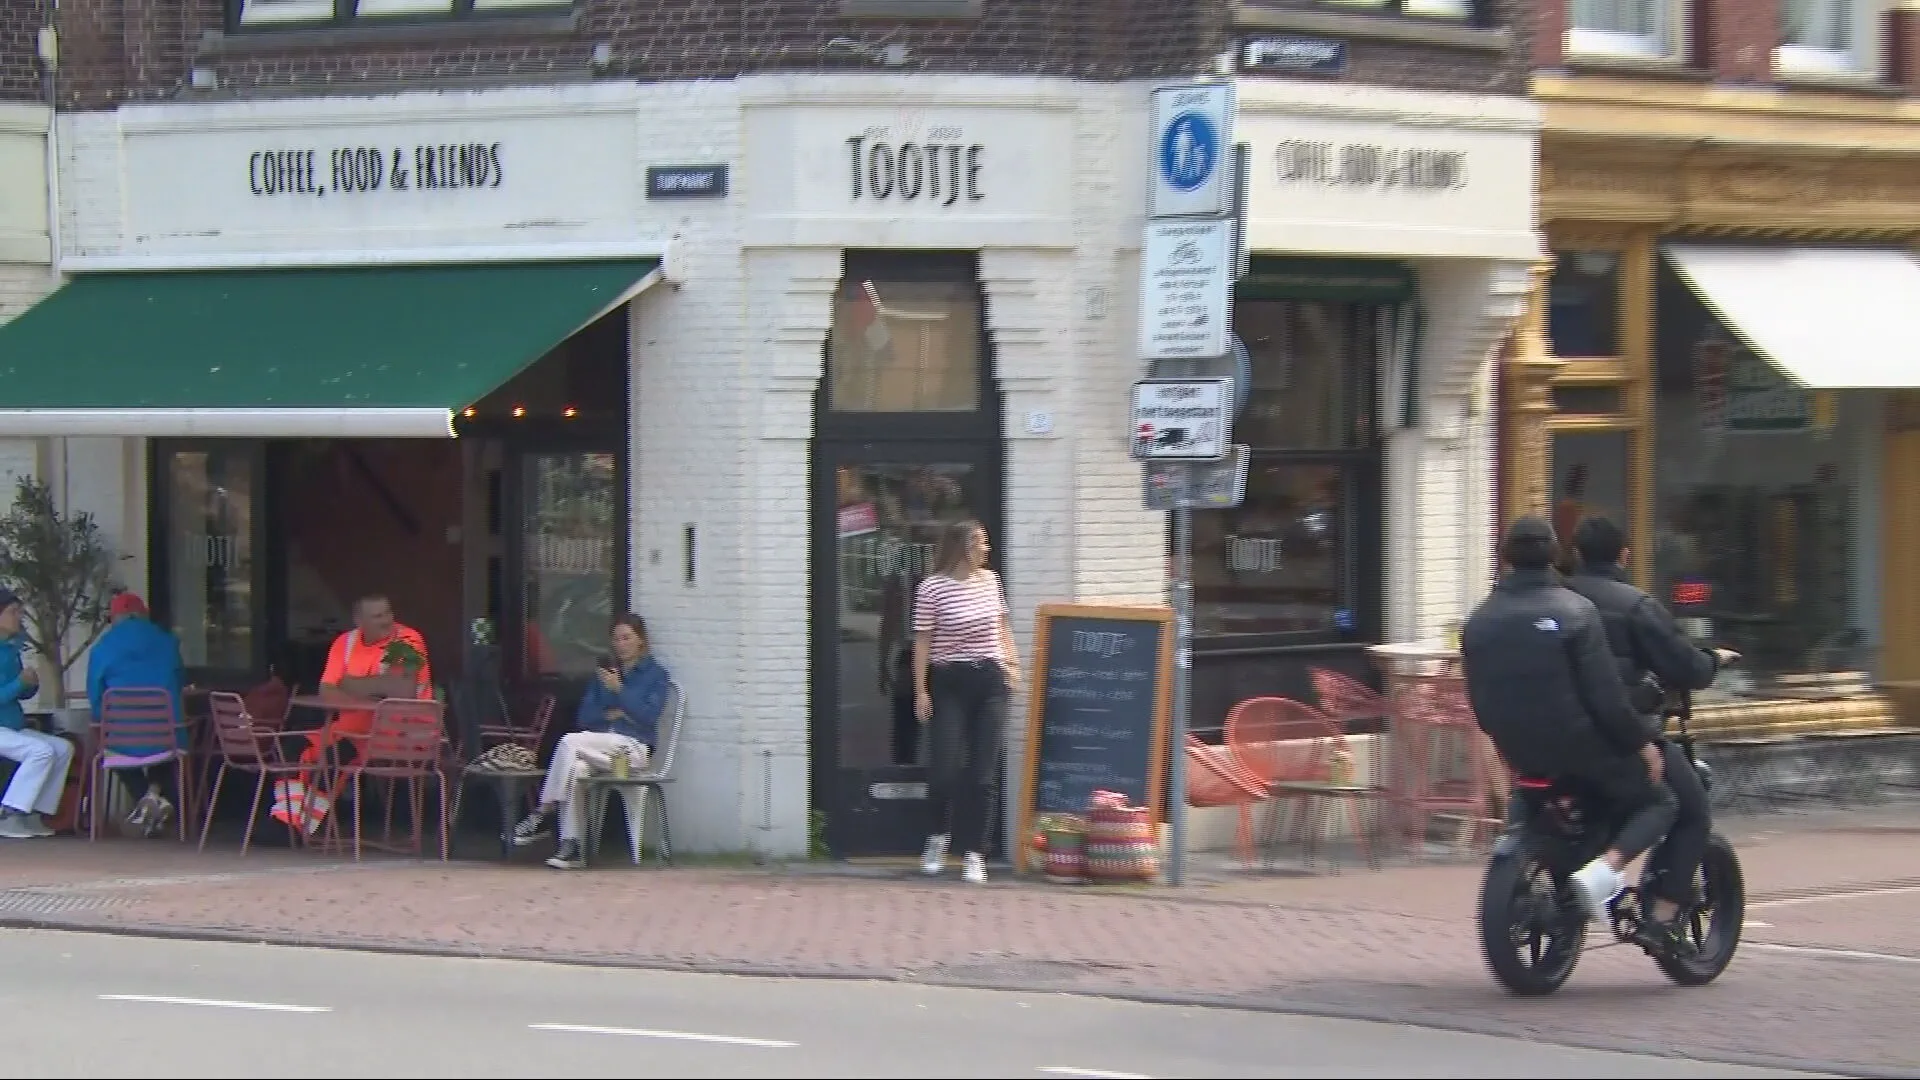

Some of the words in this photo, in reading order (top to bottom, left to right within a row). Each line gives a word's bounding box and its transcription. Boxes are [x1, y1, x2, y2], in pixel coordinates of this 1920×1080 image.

[1172, 92, 1211, 107] ZONE
[250, 149, 324, 196] COFFEE,
[330, 147, 383, 192] FOOD
[390, 148, 409, 190] &
[415, 142, 504, 190] FRIENDS
[656, 171, 714, 190] TURFMARKT
[845, 135, 985, 207] TOOTJE
